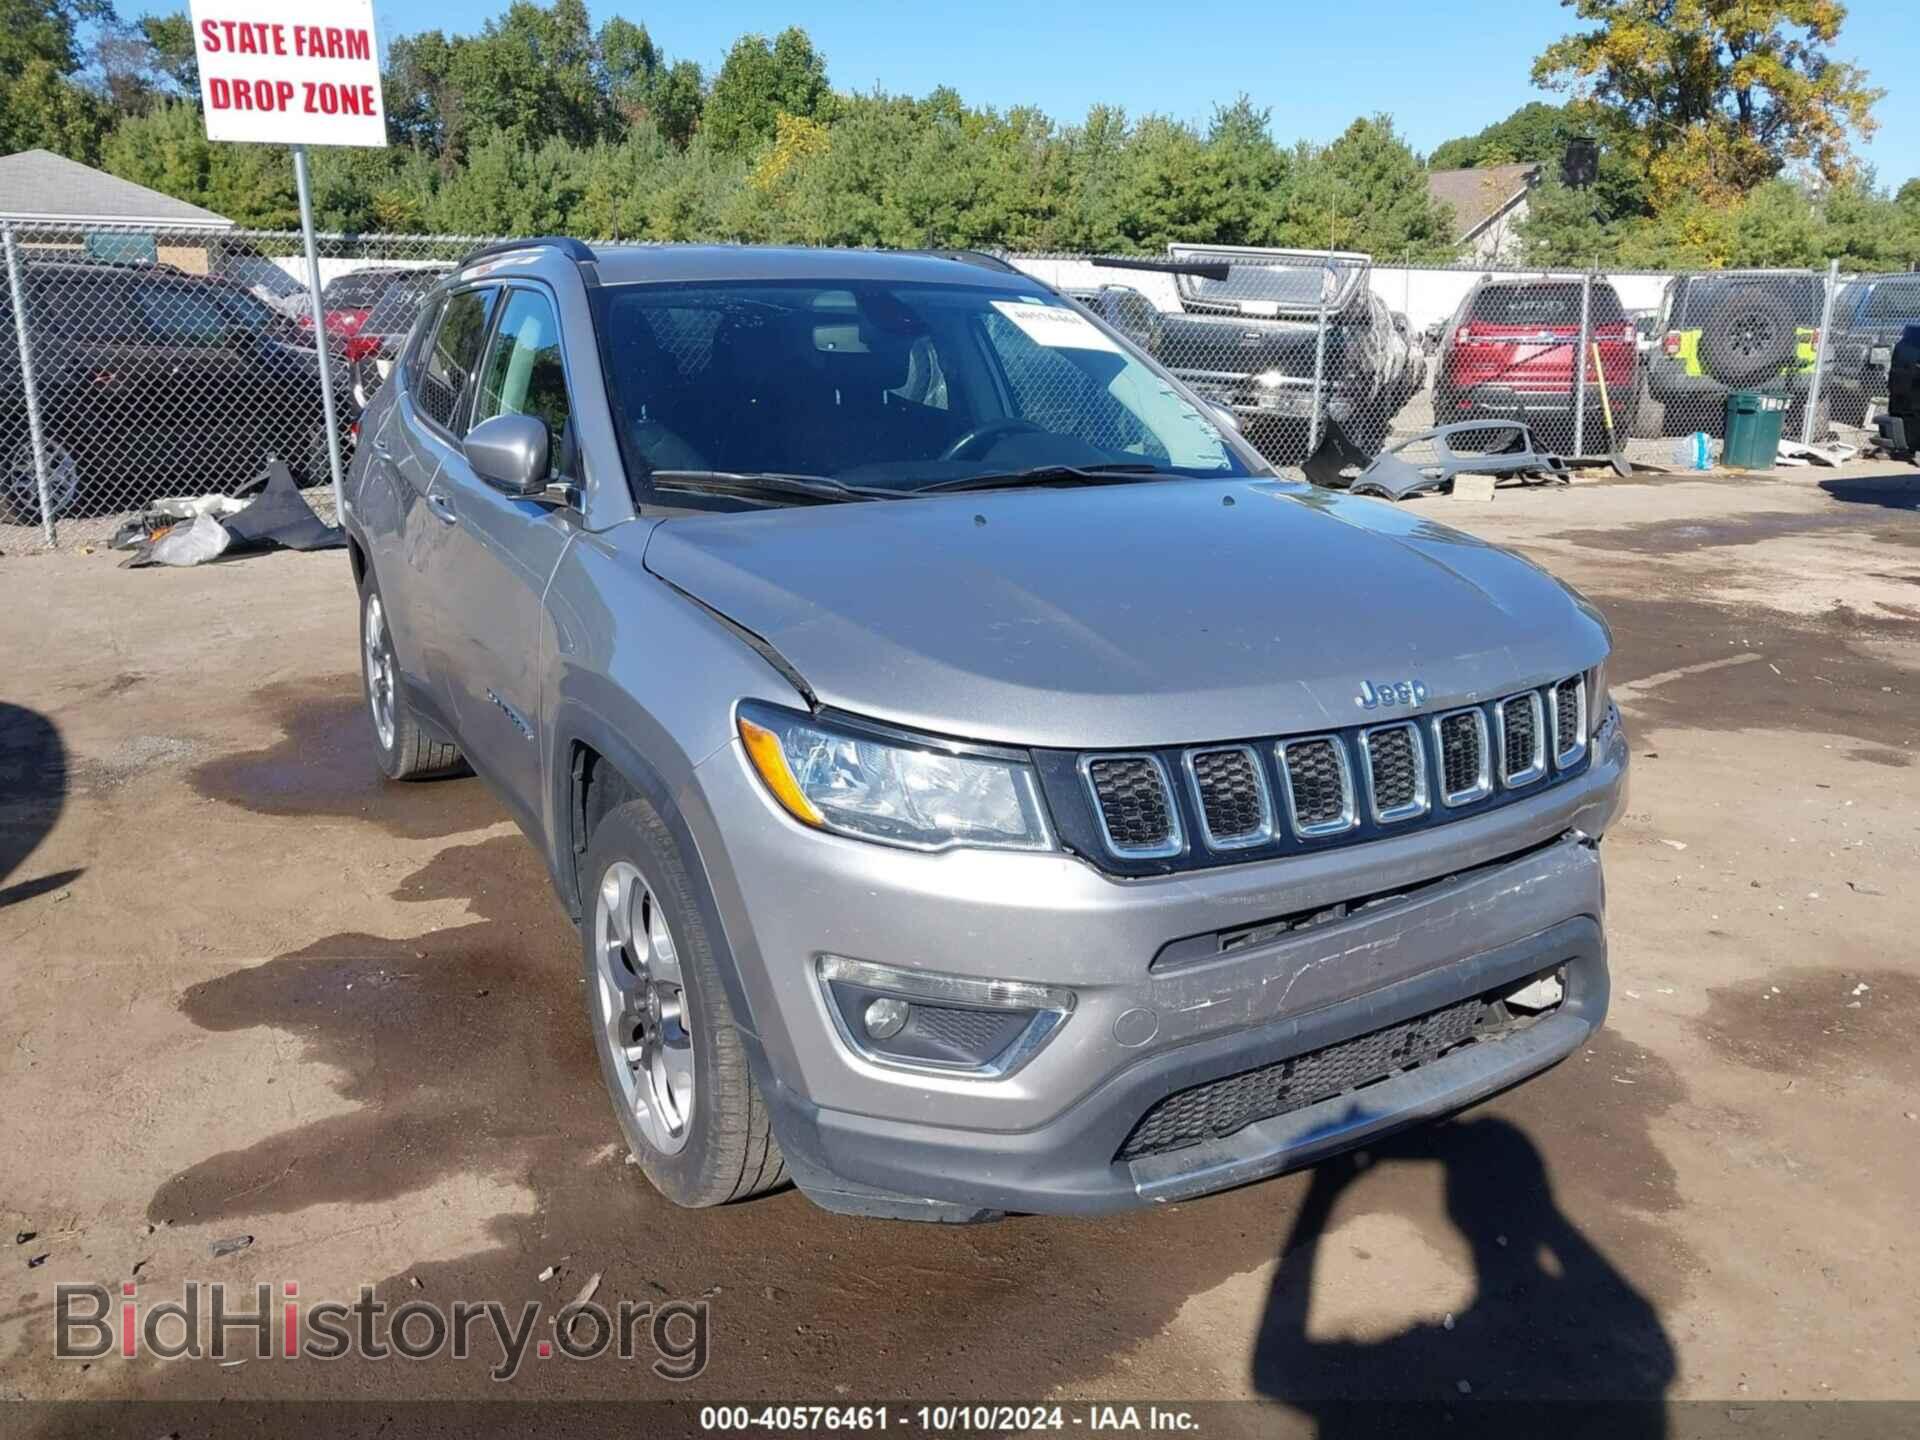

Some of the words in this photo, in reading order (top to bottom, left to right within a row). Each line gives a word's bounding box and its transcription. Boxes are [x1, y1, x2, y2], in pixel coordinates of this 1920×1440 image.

[201, 19, 287, 56] STATE
[293, 25, 370, 60] FARM
[209, 78, 294, 111] DROP
[302, 83, 376, 116] ZONE
[1355, 680, 1426, 709] Jeep
